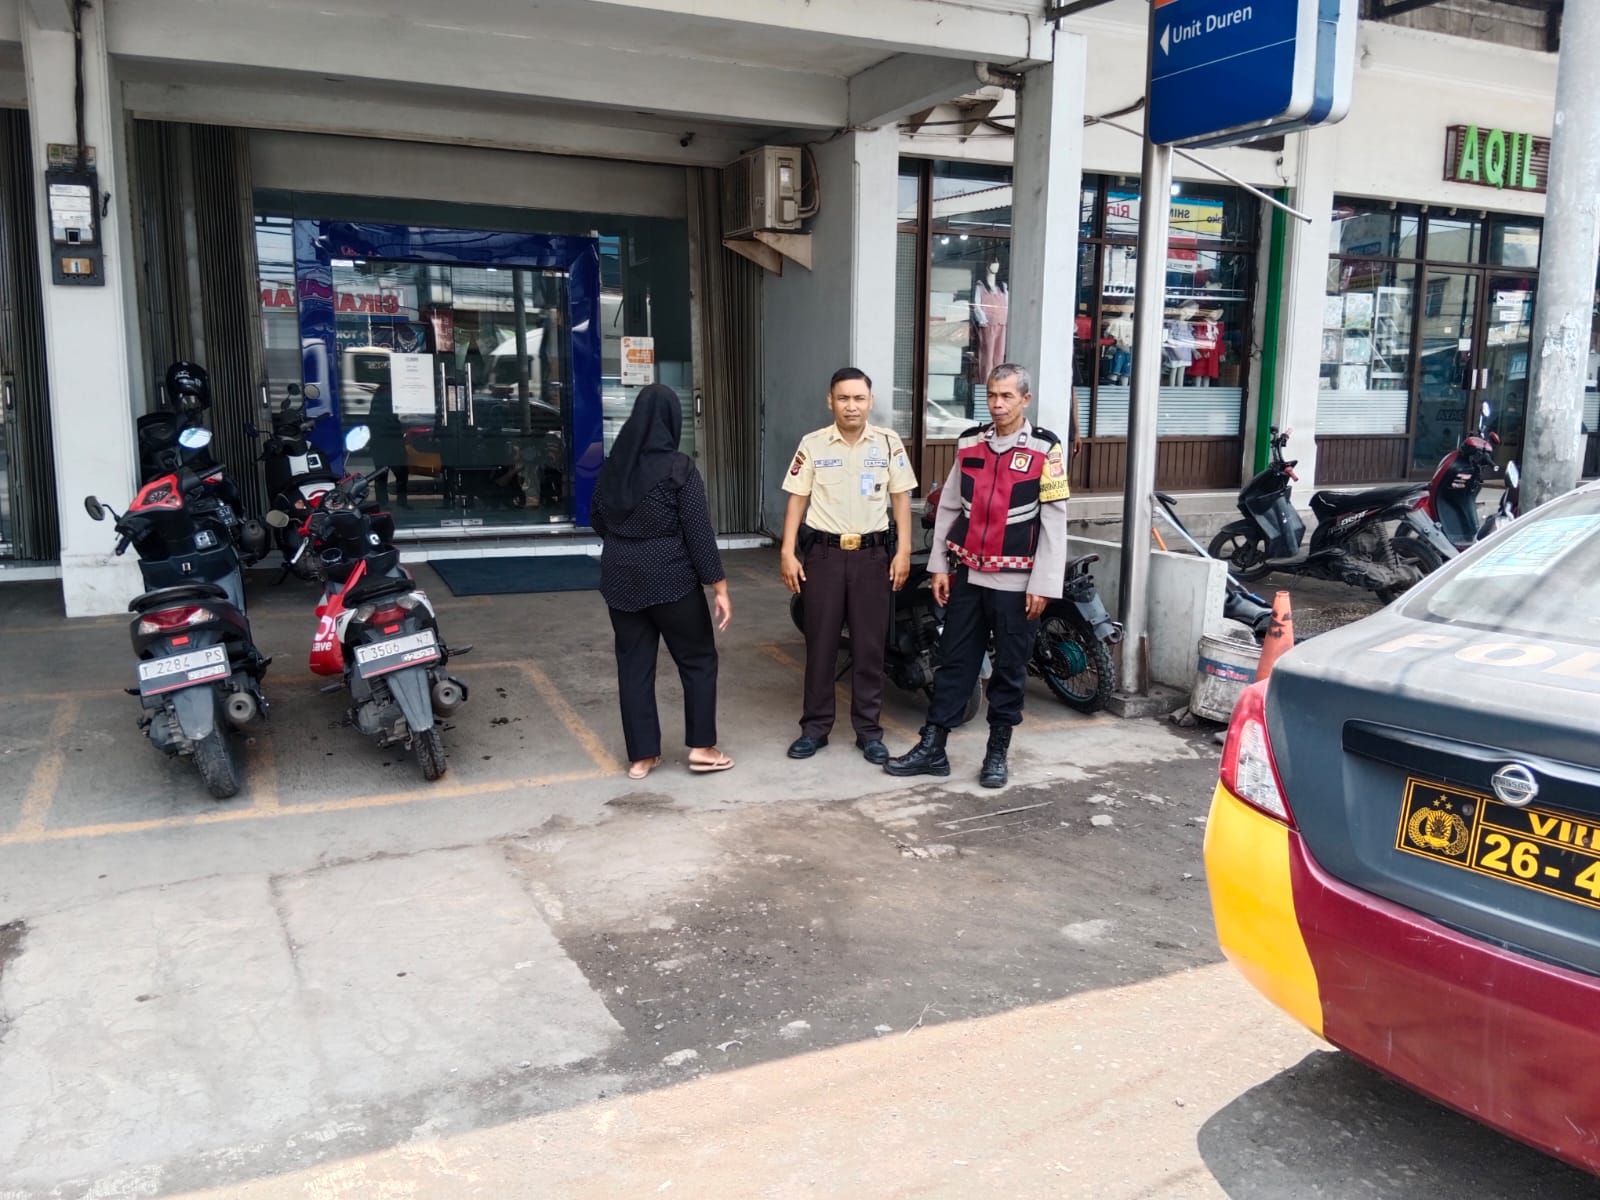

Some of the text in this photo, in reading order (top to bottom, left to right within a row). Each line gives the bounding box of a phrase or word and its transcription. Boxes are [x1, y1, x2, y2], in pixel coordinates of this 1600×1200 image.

[1172, 6, 1253, 44] Unit Duren
[1456, 123, 1538, 190] AQIL
[142, 649, 222, 678] T 2284 PS
[358, 650, 366, 662] T
[370, 643, 400, 659] 3506
